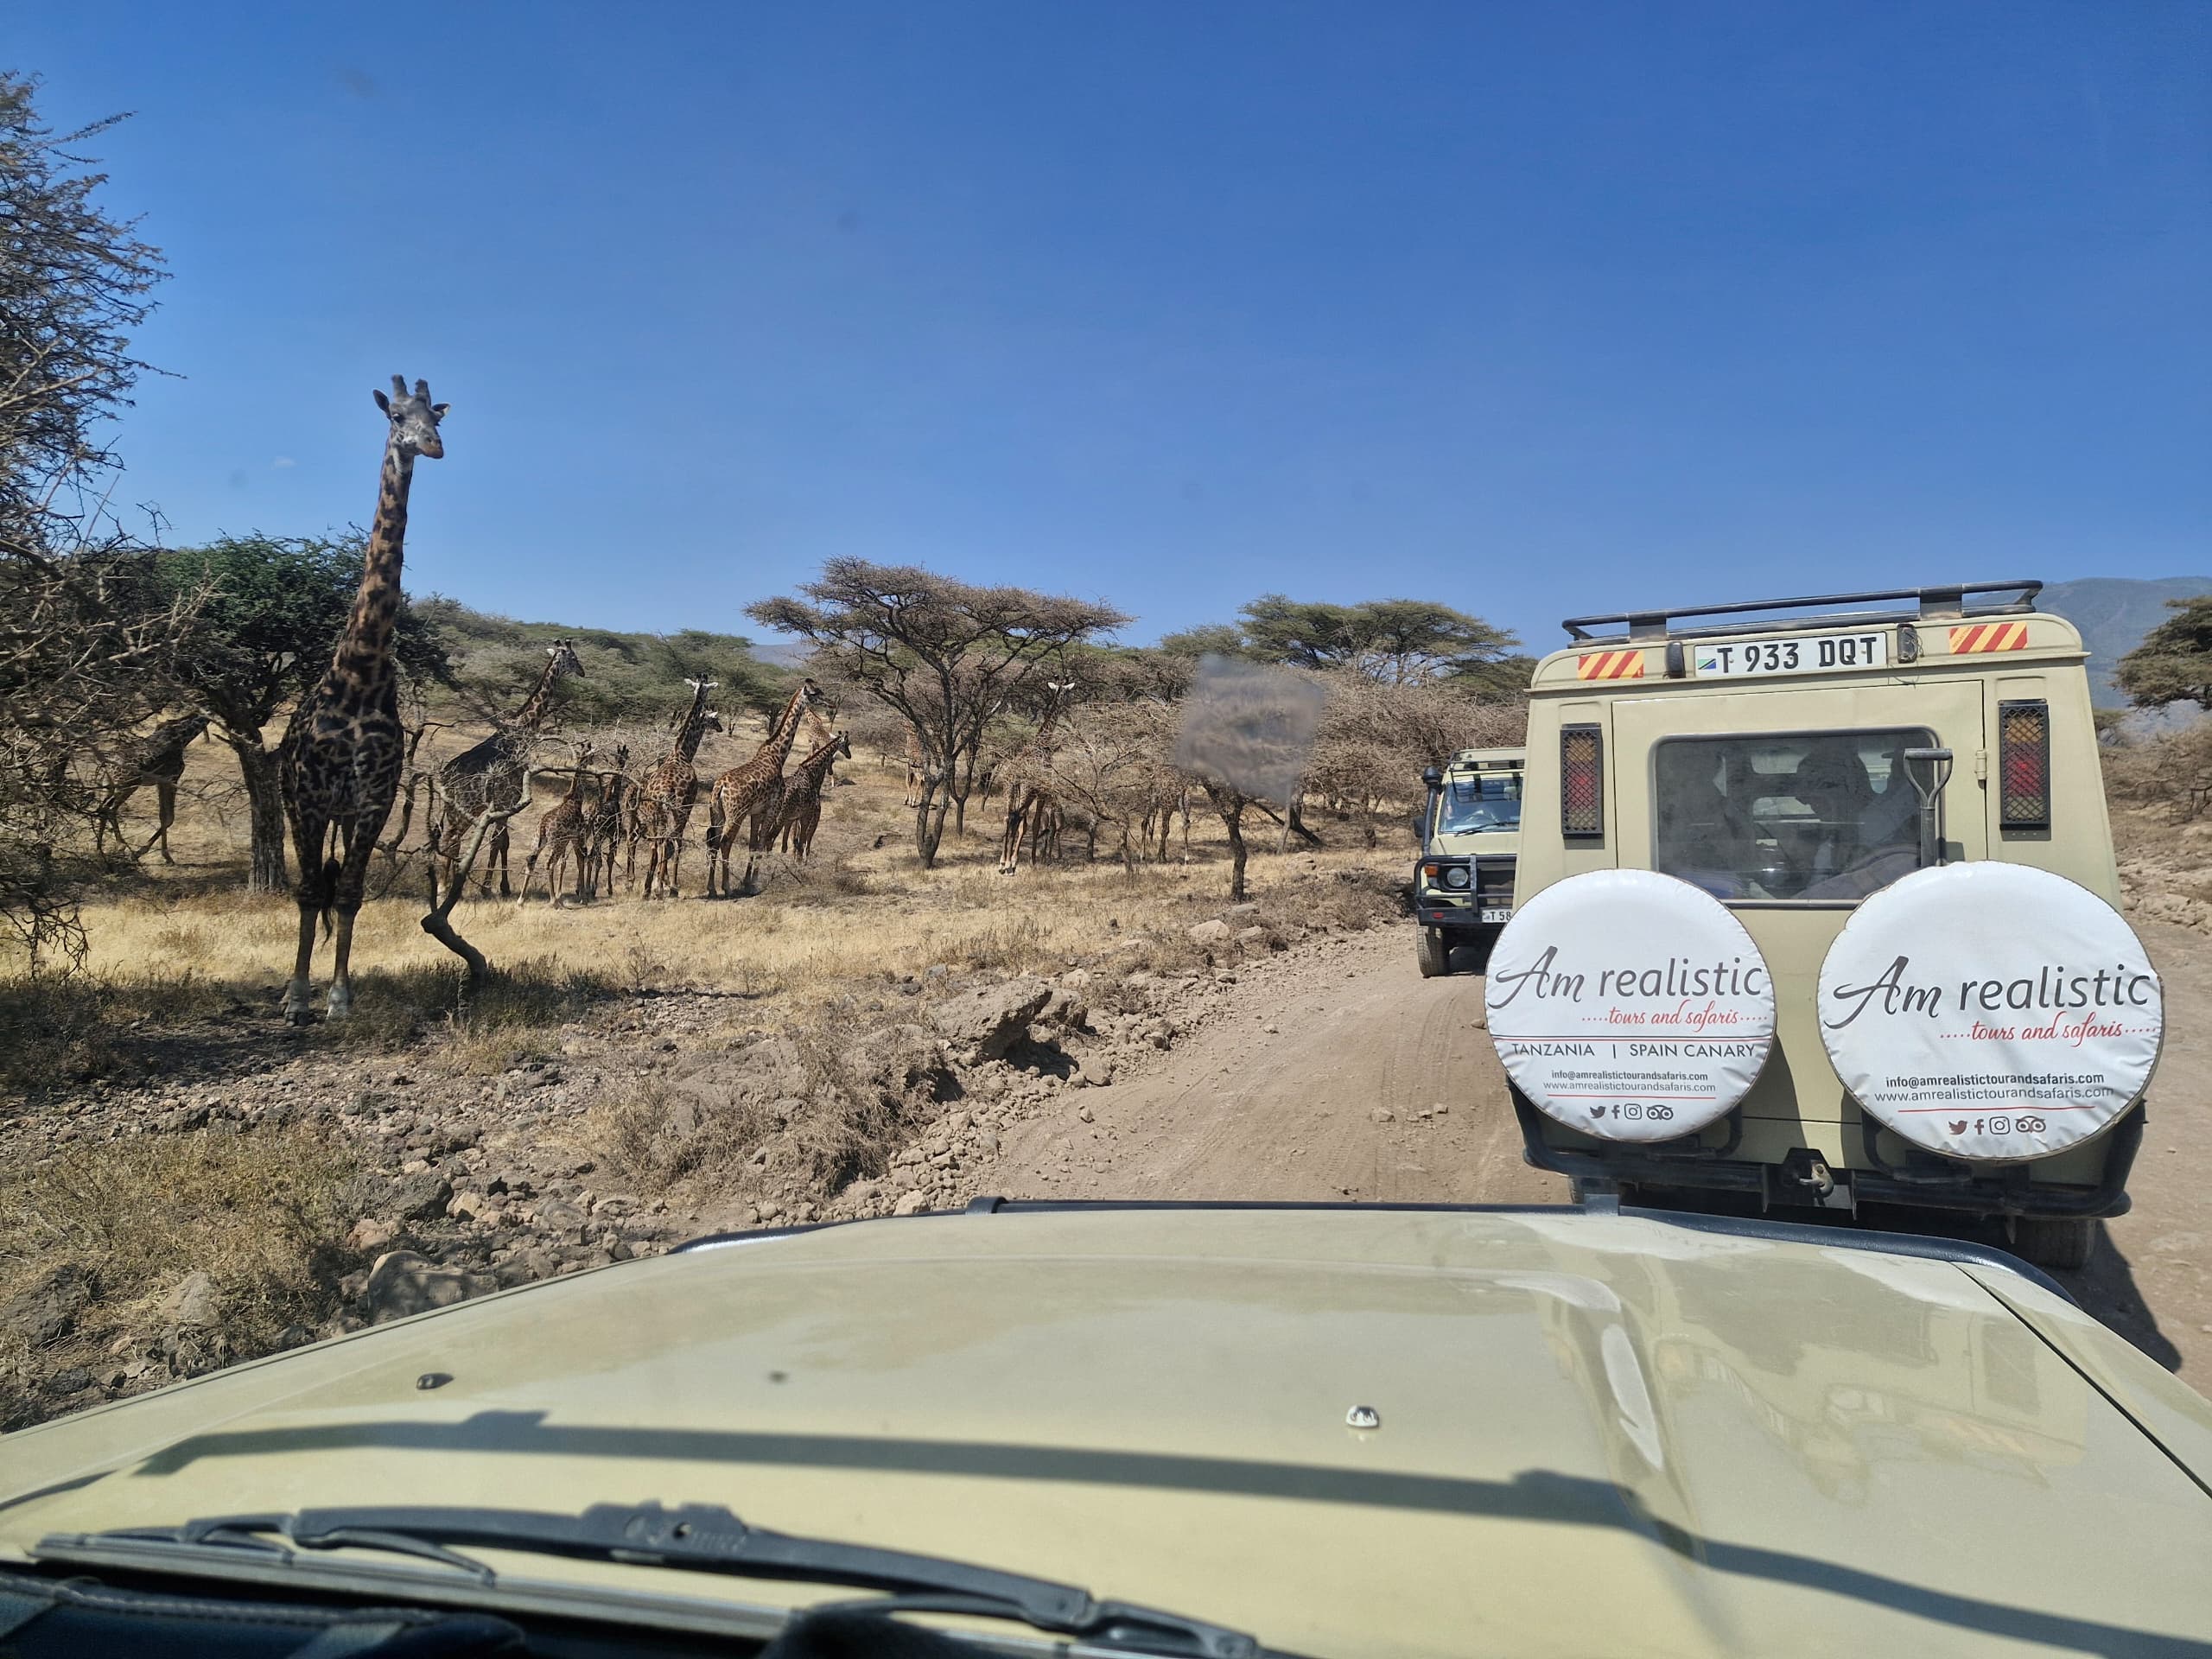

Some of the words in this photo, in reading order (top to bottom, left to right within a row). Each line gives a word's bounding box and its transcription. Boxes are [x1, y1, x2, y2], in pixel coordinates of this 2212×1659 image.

[1717, 647, 1732, 673] T
[1745, 642, 1799, 672] 933
[1818, 637, 1877, 667] DQT
[1491, 912, 1496, 920] T
[1487, 945, 1585, 1010] Am
[1599, 957, 1763, 997] realistic
[1823, 955, 1942, 1030] Am
[1959, 963, 2150, 1011] realistic
[1650, 999, 1691, 1025] and
[2021, 1010, 2068, 1040] and
[1512, 1043, 1595, 1057] TANZANIA
[1629, 1044, 1678, 1057] SPAIN
[1684, 1044, 1756, 1058] CANARY
[1551, 1070, 1708, 1081] info@amrealistictourandsafaris.com
[1885, 1073, 2104, 1089] info@amrealistictourandsafaris.com
[1542, 1080, 1716, 1092] www.amrealistictourandsafaris.com
[1874, 1086, 2114, 1103] www.amrealistictourandsafaris.com
